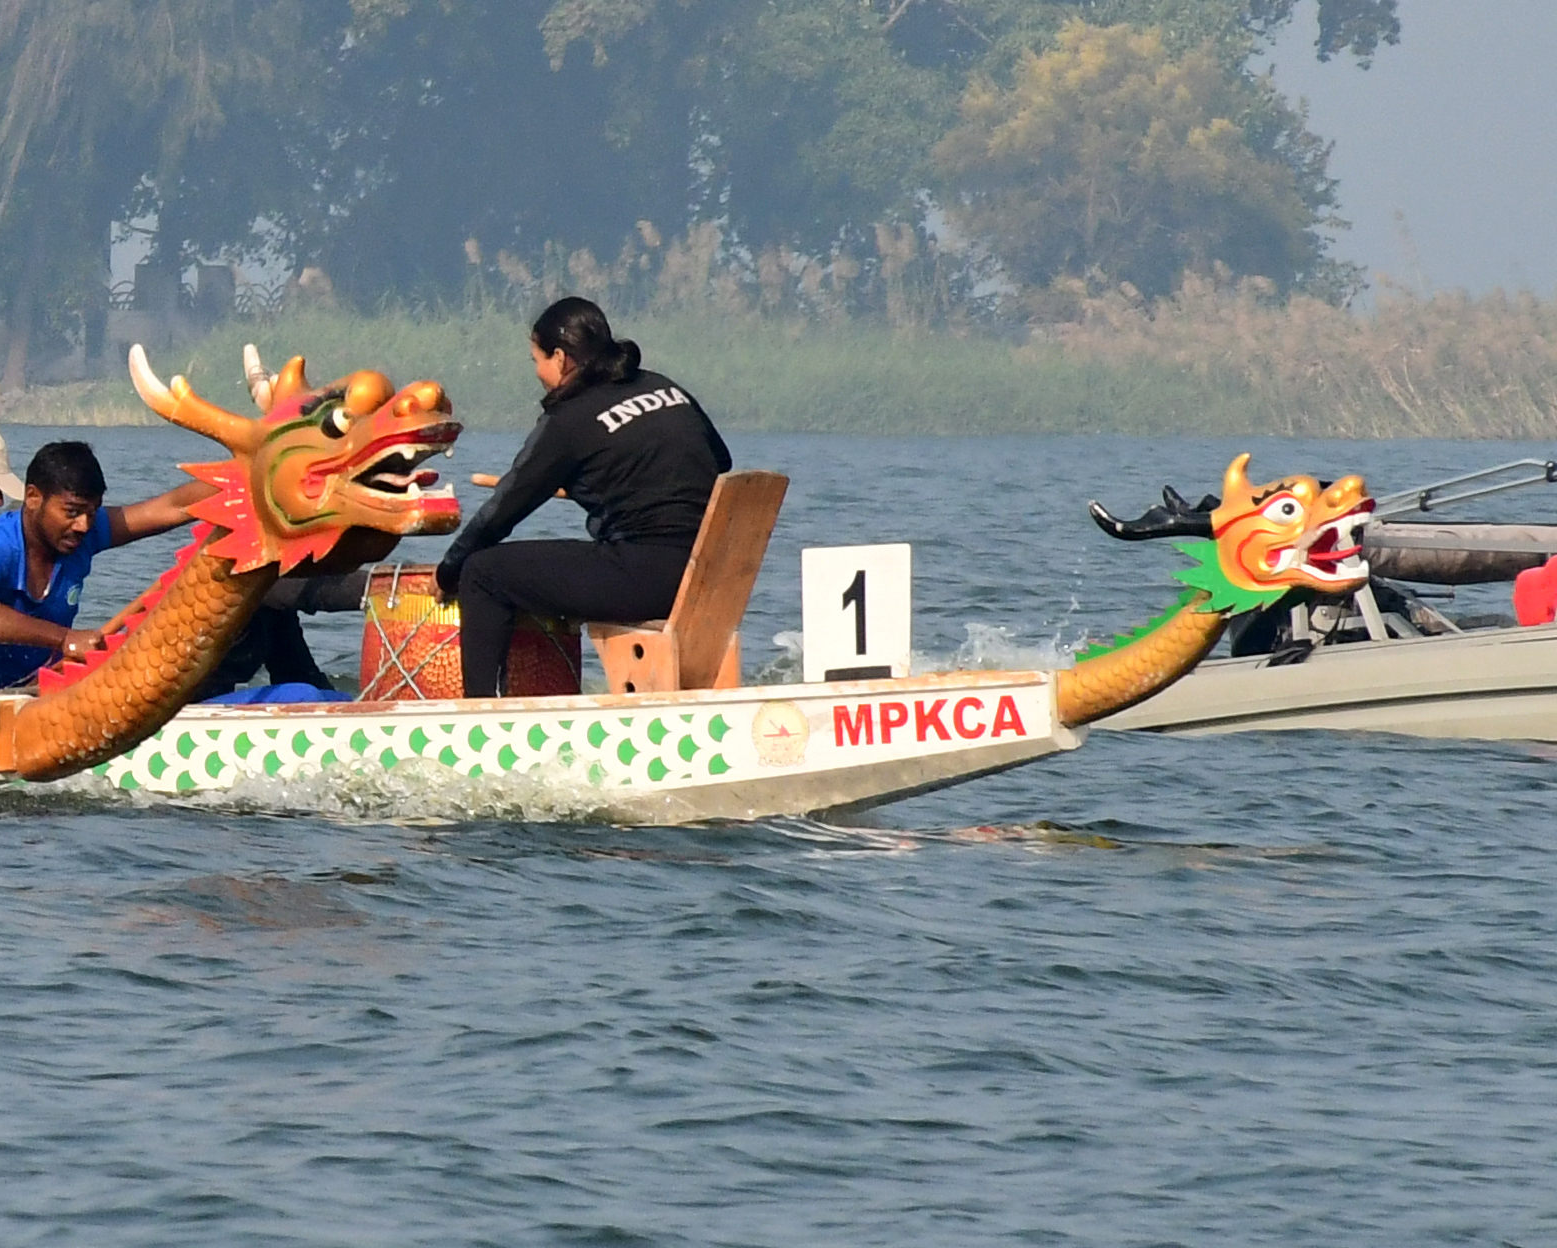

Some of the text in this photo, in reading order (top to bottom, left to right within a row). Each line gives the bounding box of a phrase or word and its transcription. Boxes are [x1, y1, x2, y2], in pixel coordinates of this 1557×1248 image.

[596, 386, 691, 434] INDIA
[842, 569, 867, 656] 1
[832, 695, 1027, 748] MPKCA
